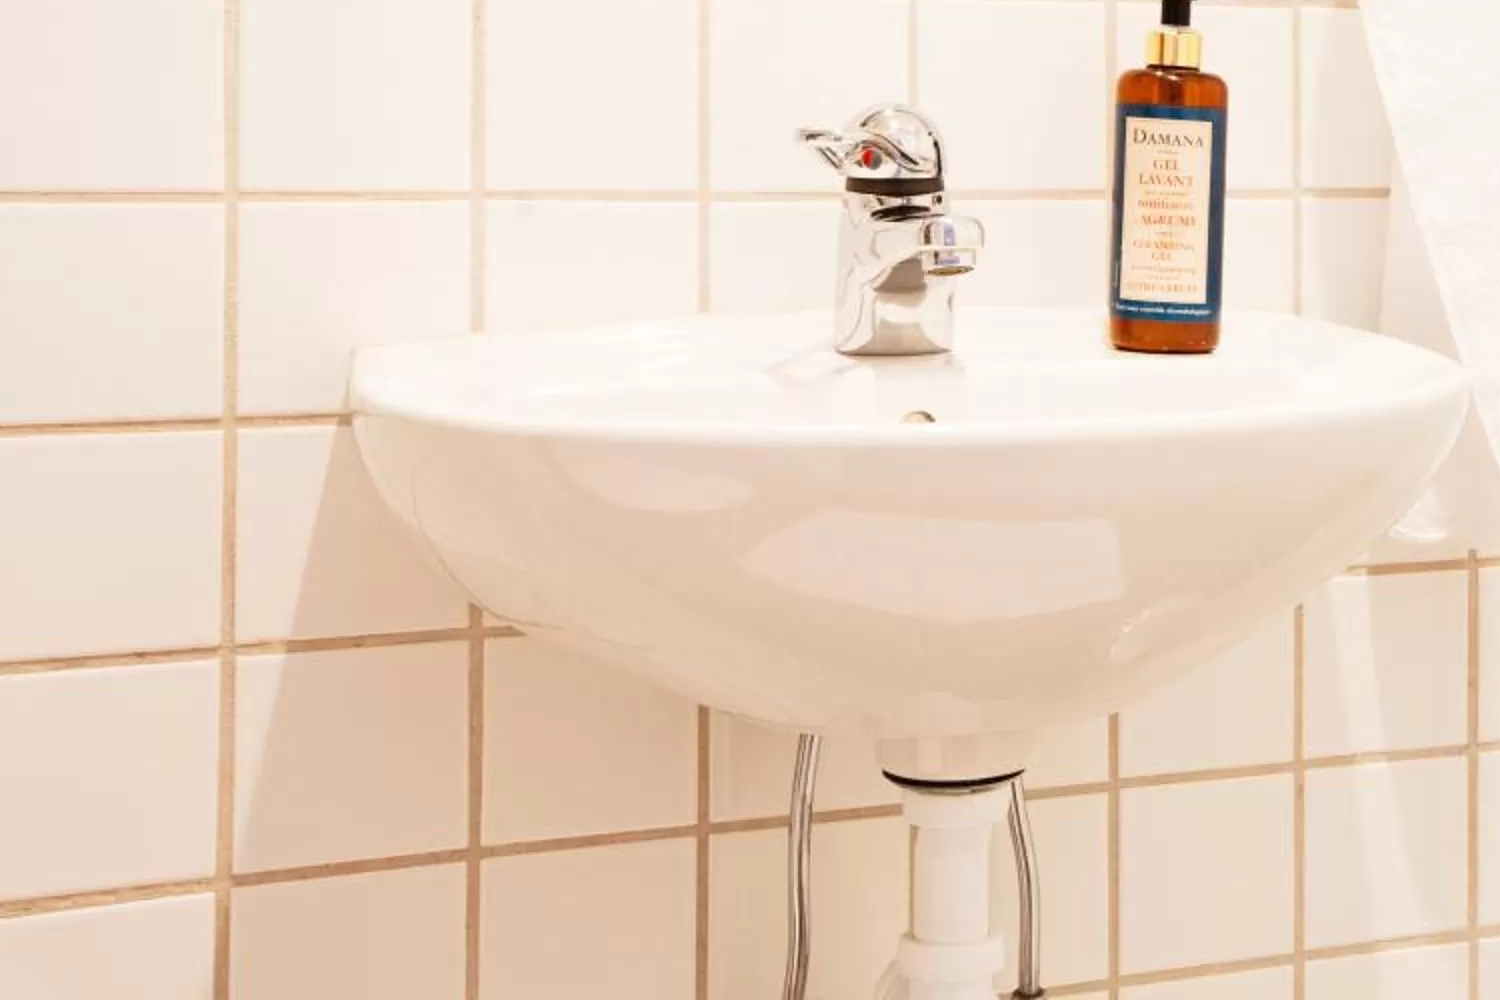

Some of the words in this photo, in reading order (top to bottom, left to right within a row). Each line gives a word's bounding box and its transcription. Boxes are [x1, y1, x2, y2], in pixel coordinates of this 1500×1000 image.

[1133, 127, 1204, 147] DAMANA
[1153, 159, 1180, 171] GEL
[1139, 173, 1193, 187] LAVANT
